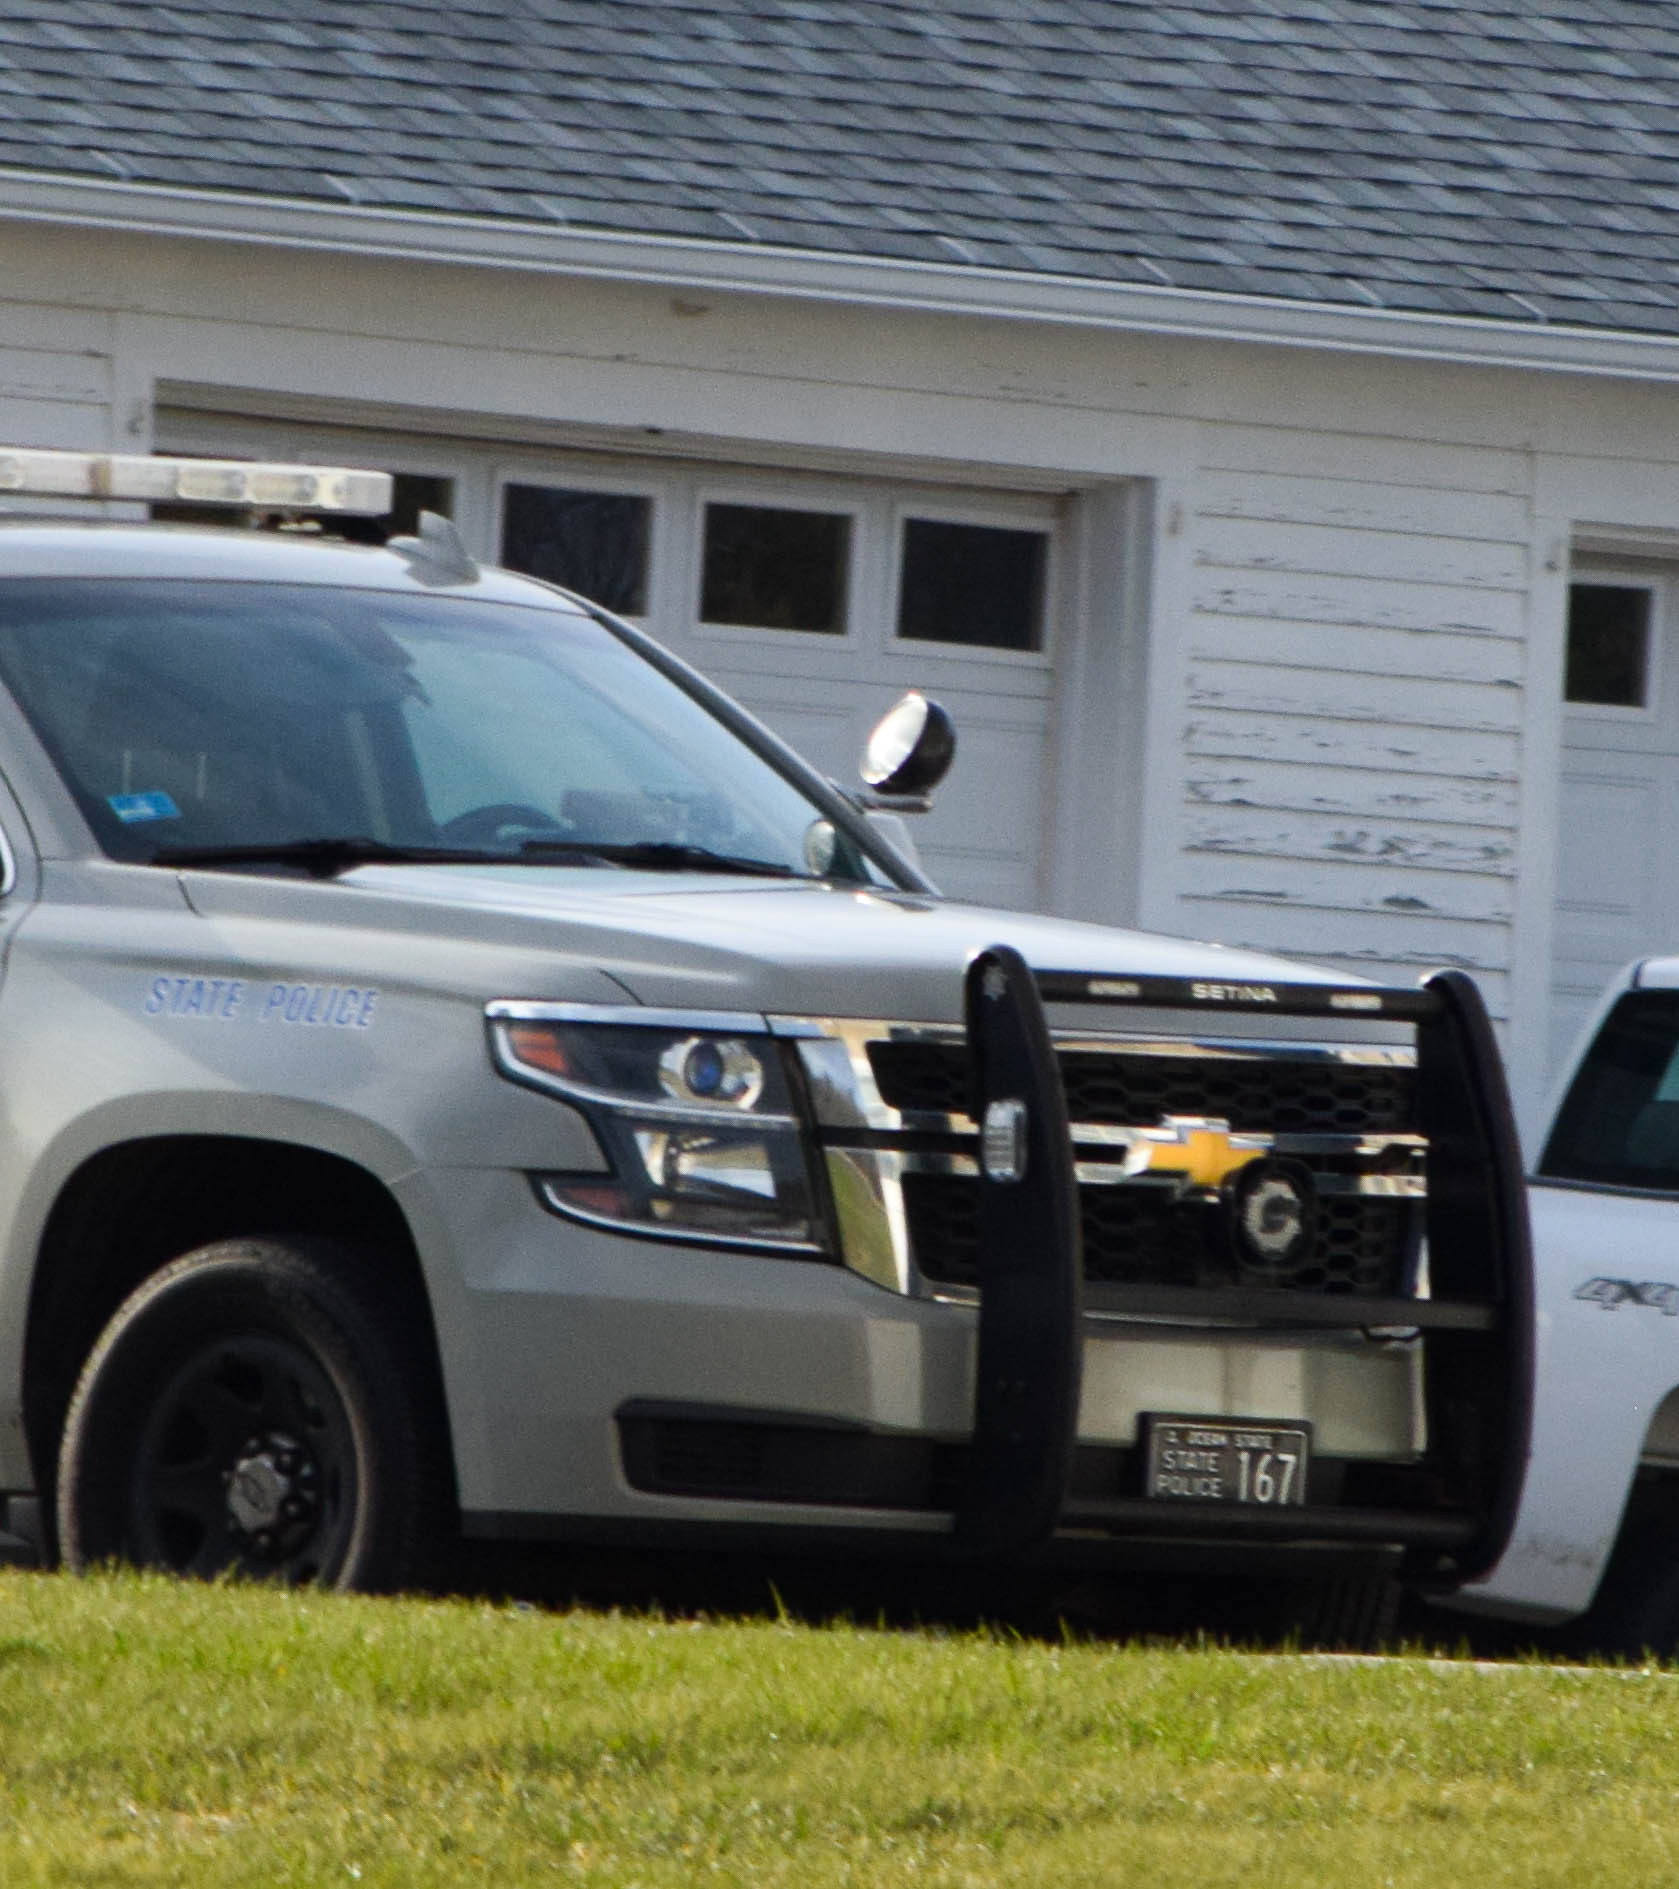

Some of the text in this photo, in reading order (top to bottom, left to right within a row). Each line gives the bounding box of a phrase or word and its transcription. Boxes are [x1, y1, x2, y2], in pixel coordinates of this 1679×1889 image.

[145, 975, 377, 1028] STATE POLICE
[1191, 982, 1277, 1002] SETINA
[1156, 1473, 1224, 1498] POLICE
[1161, 1449, 1298, 1505] STATE 167
